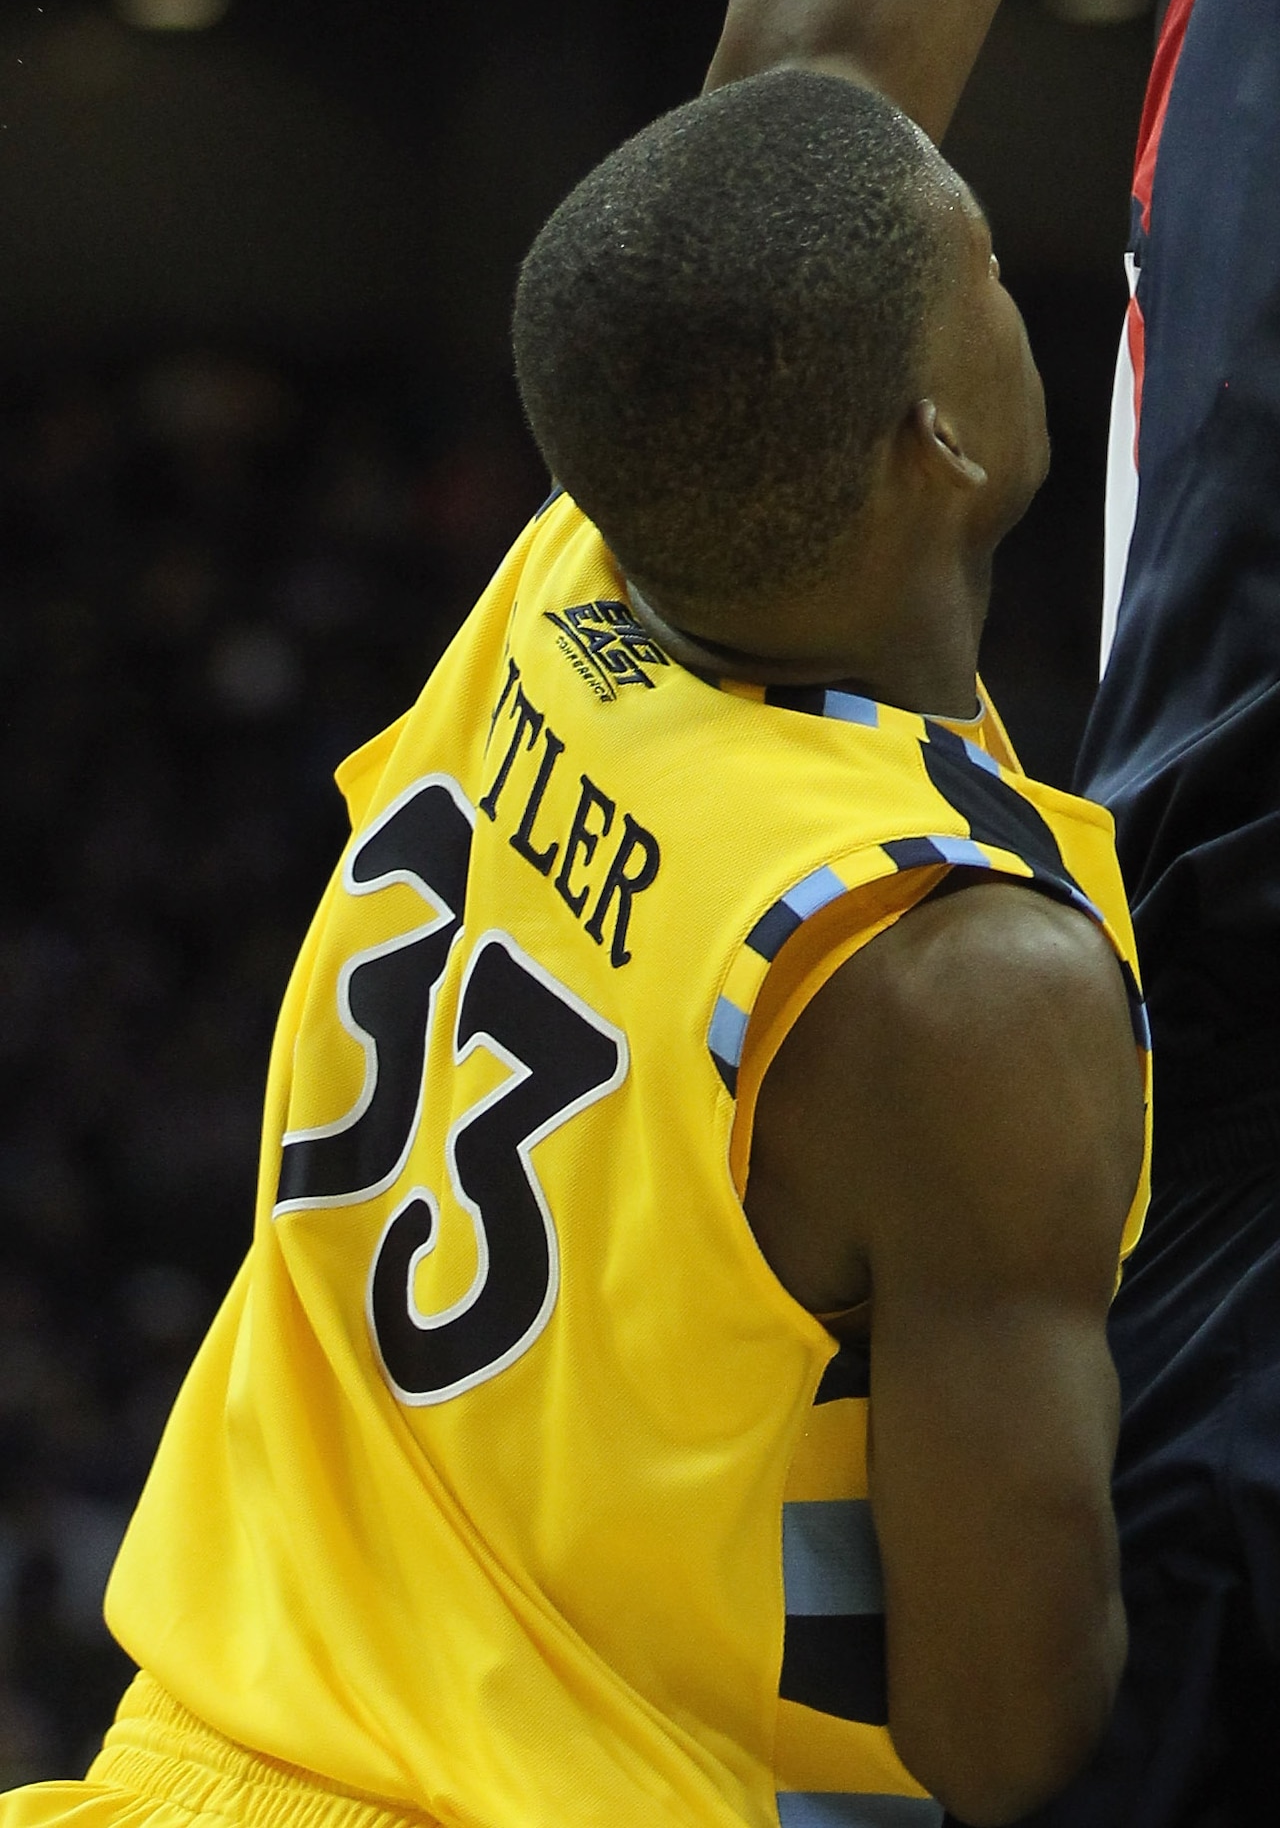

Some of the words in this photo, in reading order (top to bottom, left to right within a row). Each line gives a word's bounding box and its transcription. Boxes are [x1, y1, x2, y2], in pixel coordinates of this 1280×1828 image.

[563, 602, 657, 690] EAST
[593, 600, 671, 667] BIG
[480, 656, 660, 970] TLER
[272, 772, 629, 1408] 33
